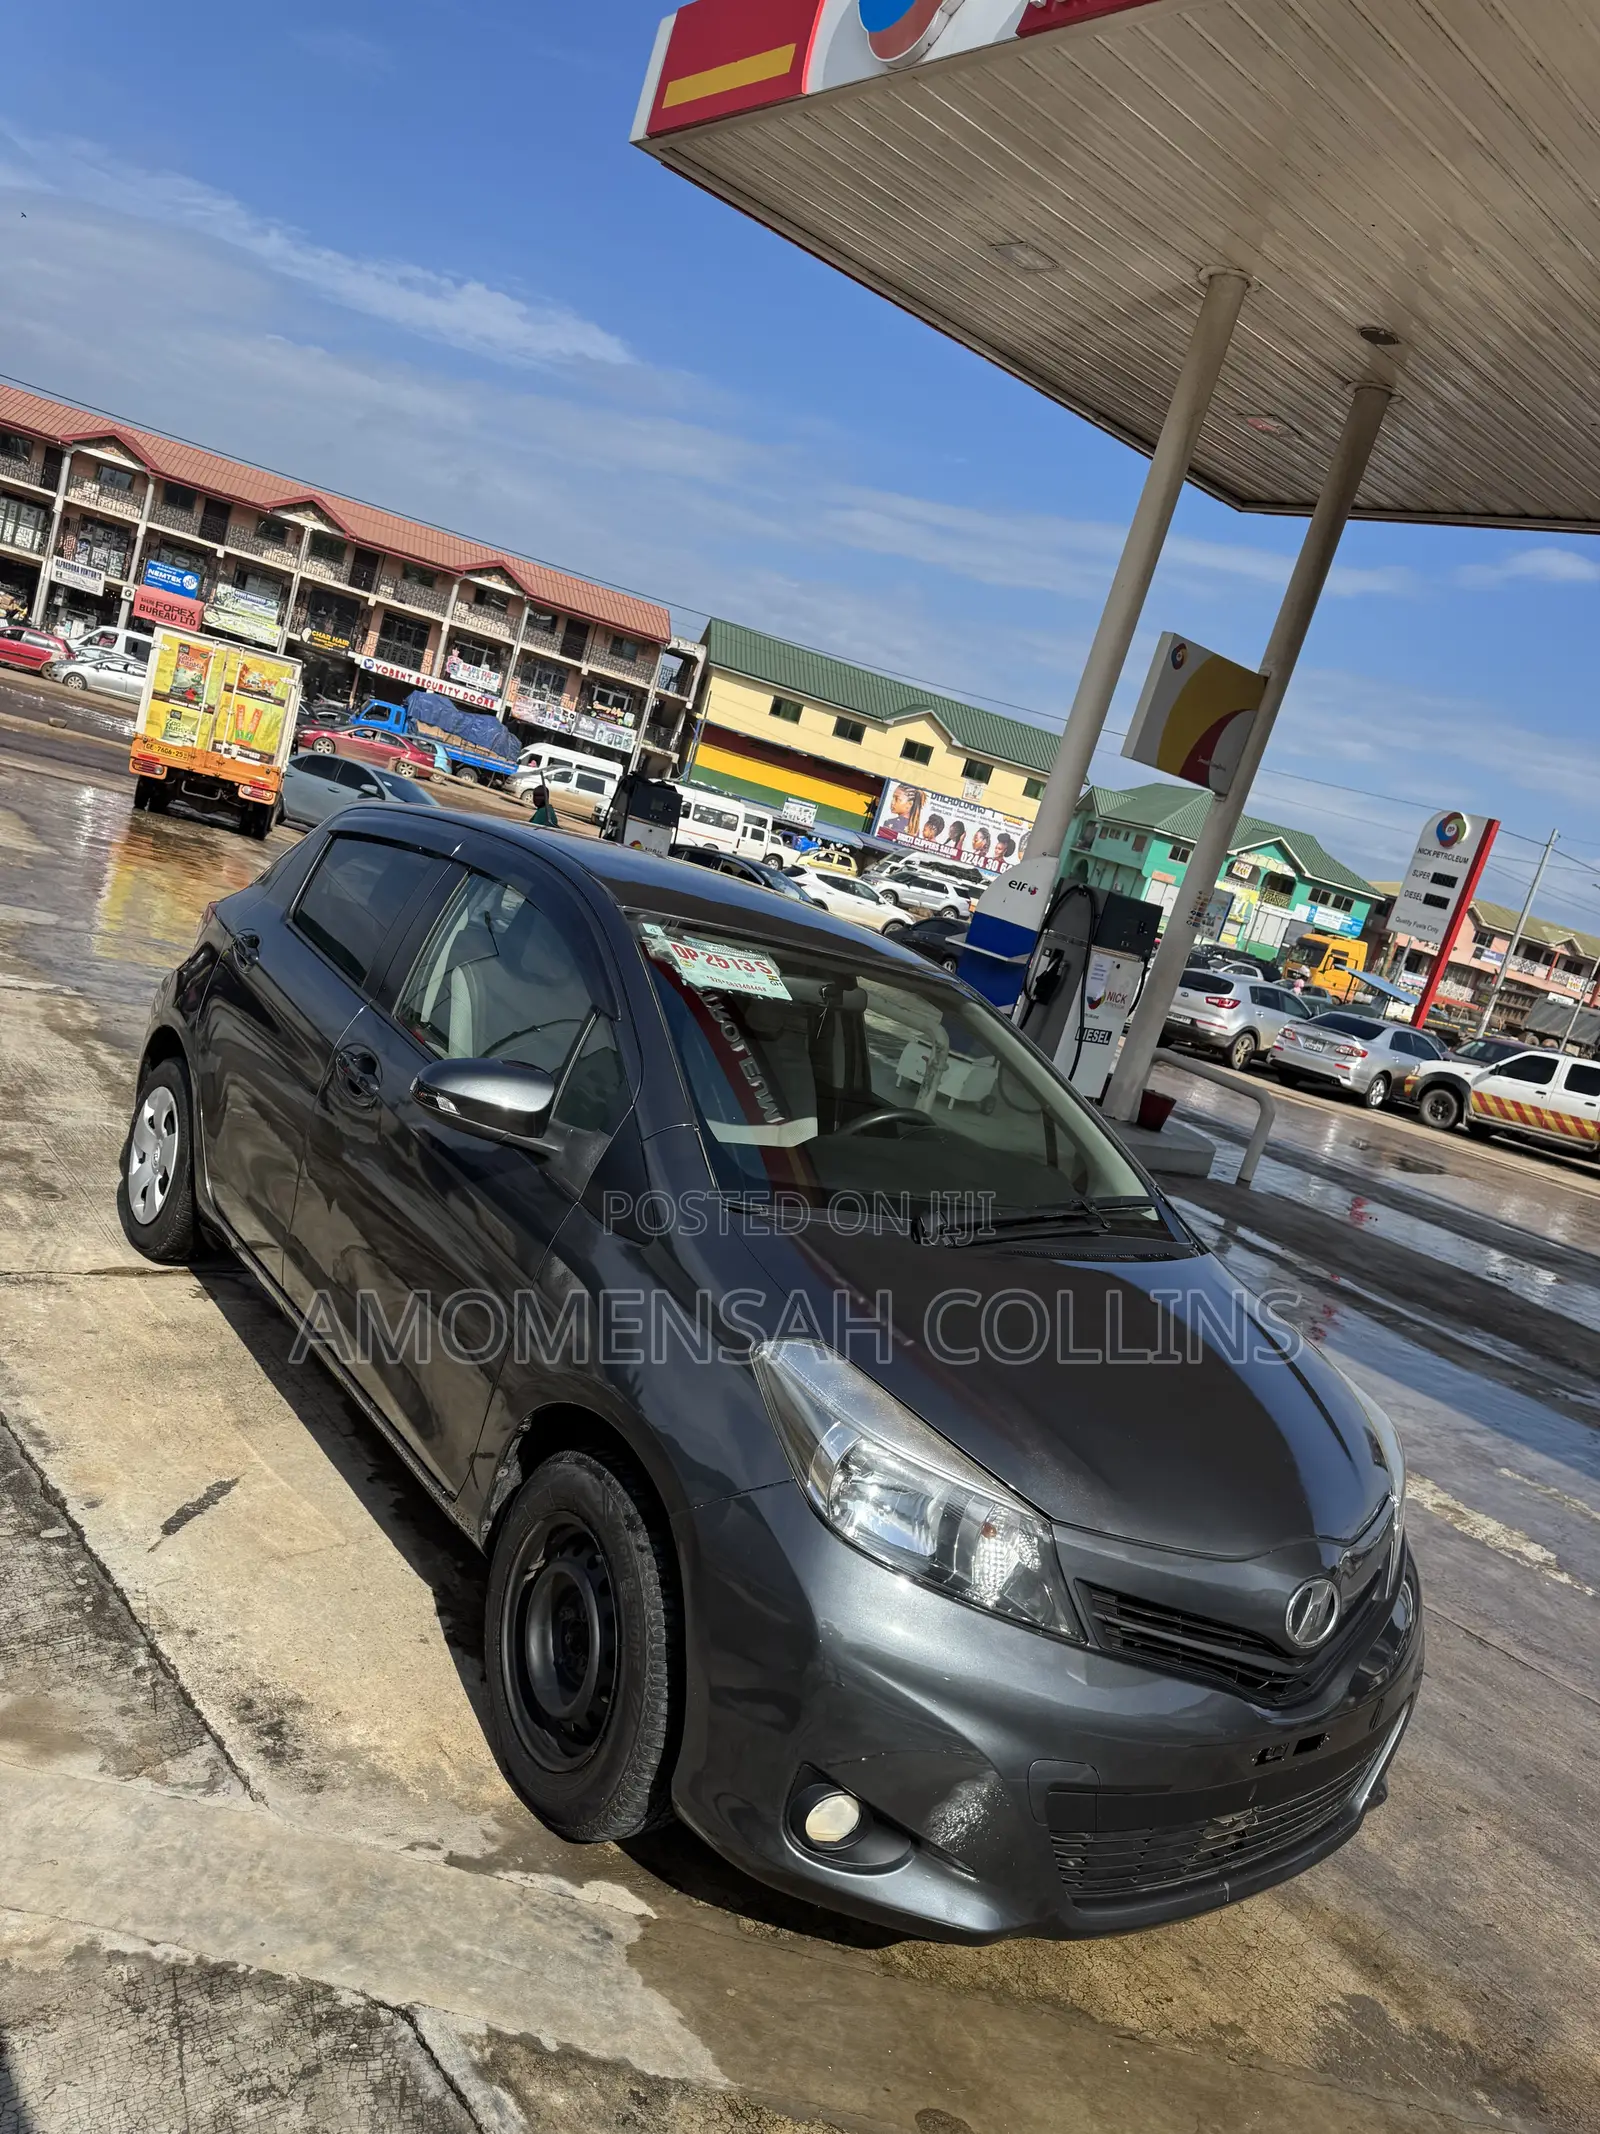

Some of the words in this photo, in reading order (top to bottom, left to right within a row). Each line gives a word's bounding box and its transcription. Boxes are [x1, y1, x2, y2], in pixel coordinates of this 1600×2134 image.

[139, 603, 177, 621] BUREAU
[180, 616, 196, 626] LTD
[155, 601, 195, 618] FOREX
[311, 630, 331, 641] CHAR
[332, 636, 350, 647] HAIR
[375, 663, 413, 683] YOBENT
[415, 677, 460, 698] SECURITY
[463, 692, 495, 708] DOORS
[960, 851, 985, 868] 0244
[985, 858, 998, 872] 30
[1417, 847, 1432, 857] NICK
[1432, 852, 1469, 864] PETROLEUM
[1412, 869, 1431, 880] SUPER
[1008, 880, 1028, 891] elf
[1404, 890, 1422, 902] DIESEL
[671, 943, 699, 961] DP
[700, 951, 756, 973] 2513
[1106, 991, 1128, 1005] NICK
